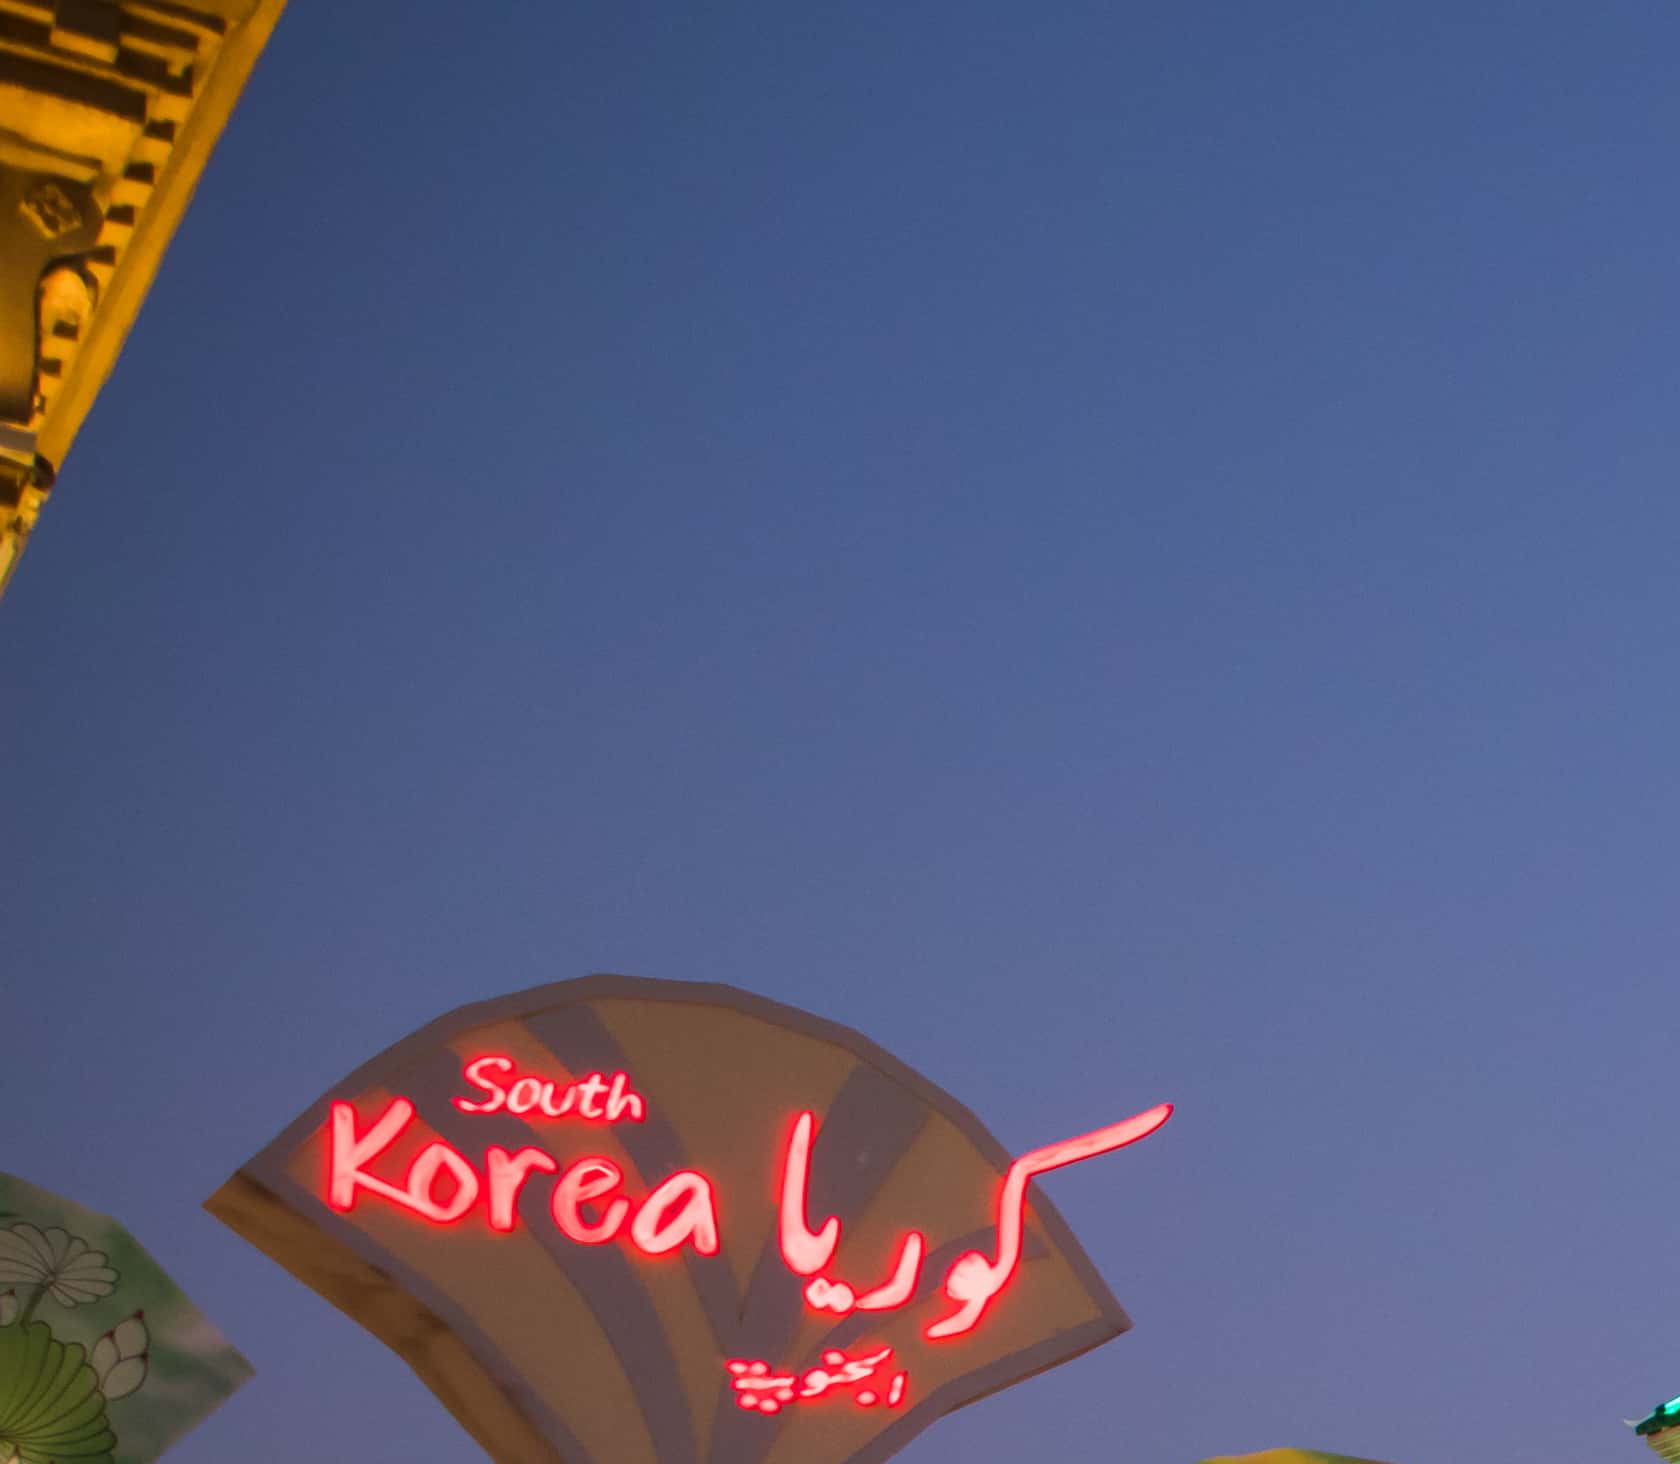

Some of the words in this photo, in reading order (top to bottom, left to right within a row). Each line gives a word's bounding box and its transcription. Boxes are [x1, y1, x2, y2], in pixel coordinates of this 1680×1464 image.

[453, 1055, 648, 1122] South
[323, 1098, 720, 1258] Korea
[775, 1104, 1176, 1340] كوريا
